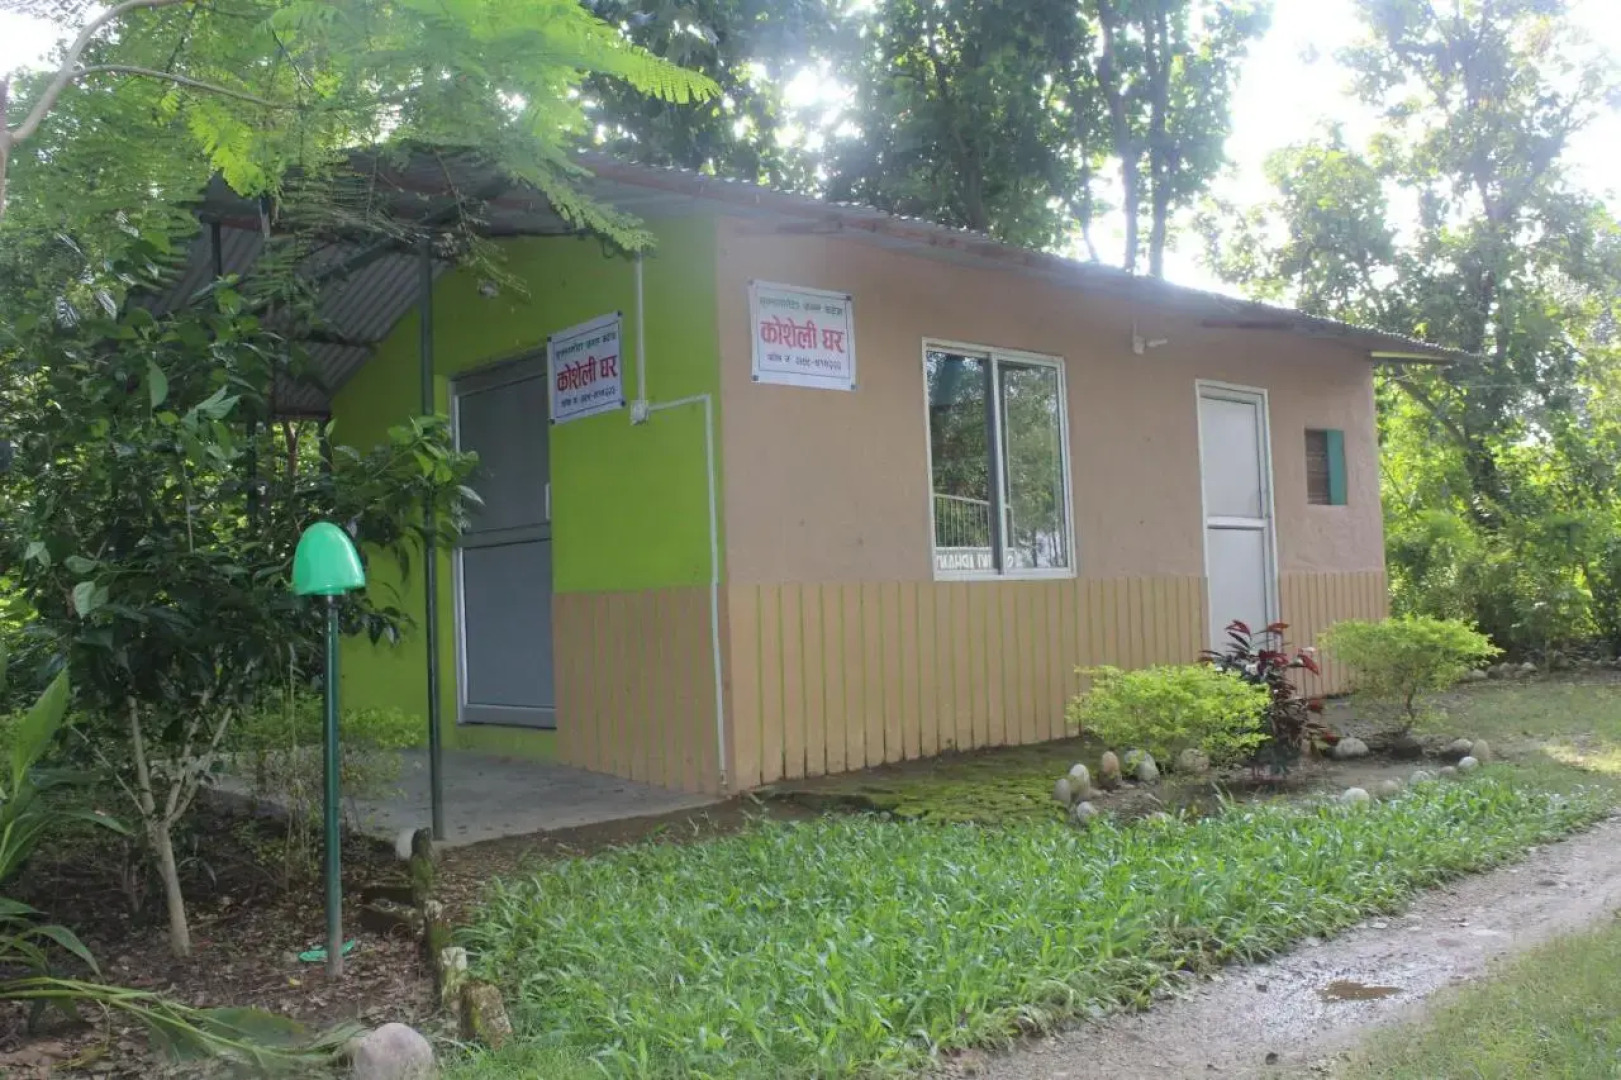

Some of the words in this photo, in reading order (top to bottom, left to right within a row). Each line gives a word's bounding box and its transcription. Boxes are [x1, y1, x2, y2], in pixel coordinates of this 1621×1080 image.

[760, 314, 817, 350] कोशेली
[821, 328, 845, 354] घर
[557, 356, 597, 391] कोशेली
[599, 355, 617, 378] घर
